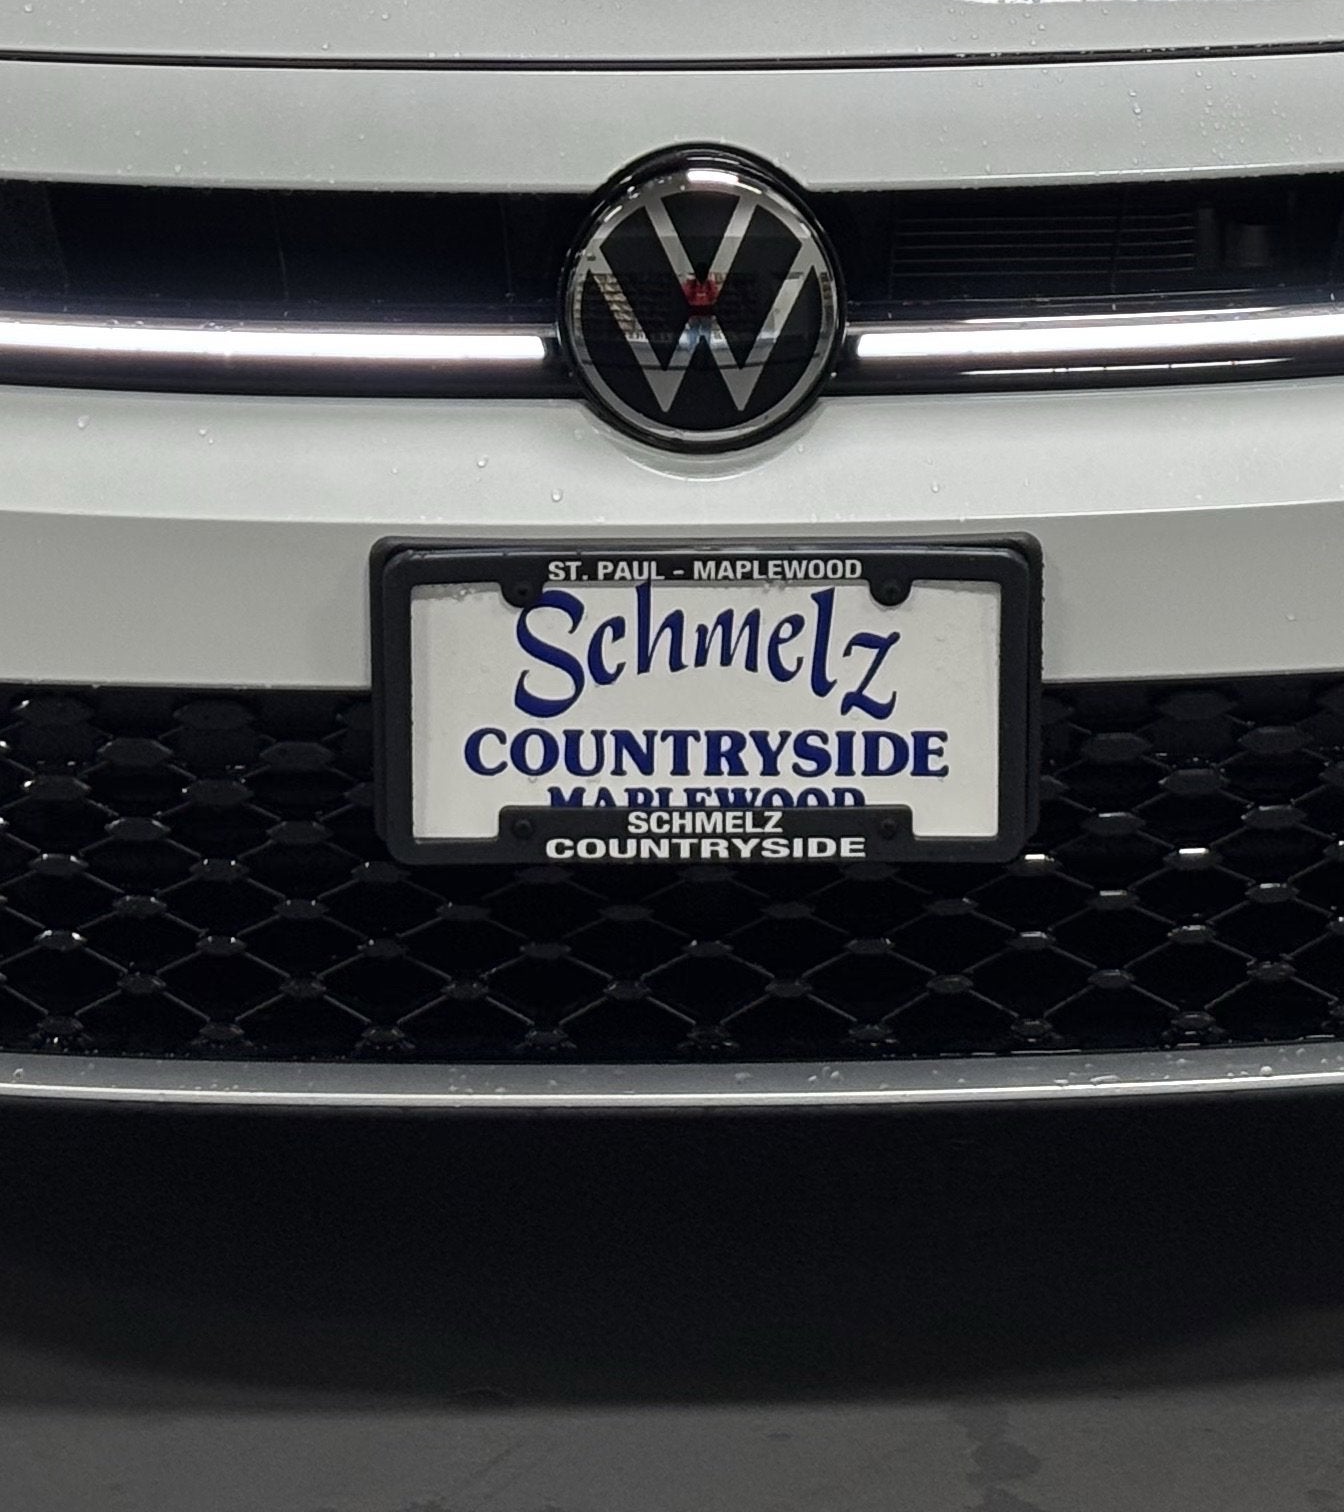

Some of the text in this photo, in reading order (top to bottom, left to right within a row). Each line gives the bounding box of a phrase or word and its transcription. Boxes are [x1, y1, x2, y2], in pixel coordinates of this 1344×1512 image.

[584, 182, 822, 422] VW
[548, 561, 589, 581] ST.
[597, 560, 665, 580] PAUL
[693, 559, 863, 580] MAPLEWOOD
[513, 579, 901, 720] Schmelz
[463, 727, 949, 778] COUNTRYSIDE
[627, 811, 784, 835] SCHMELZ
[545, 838, 867, 860] COUNTRYSIDE
